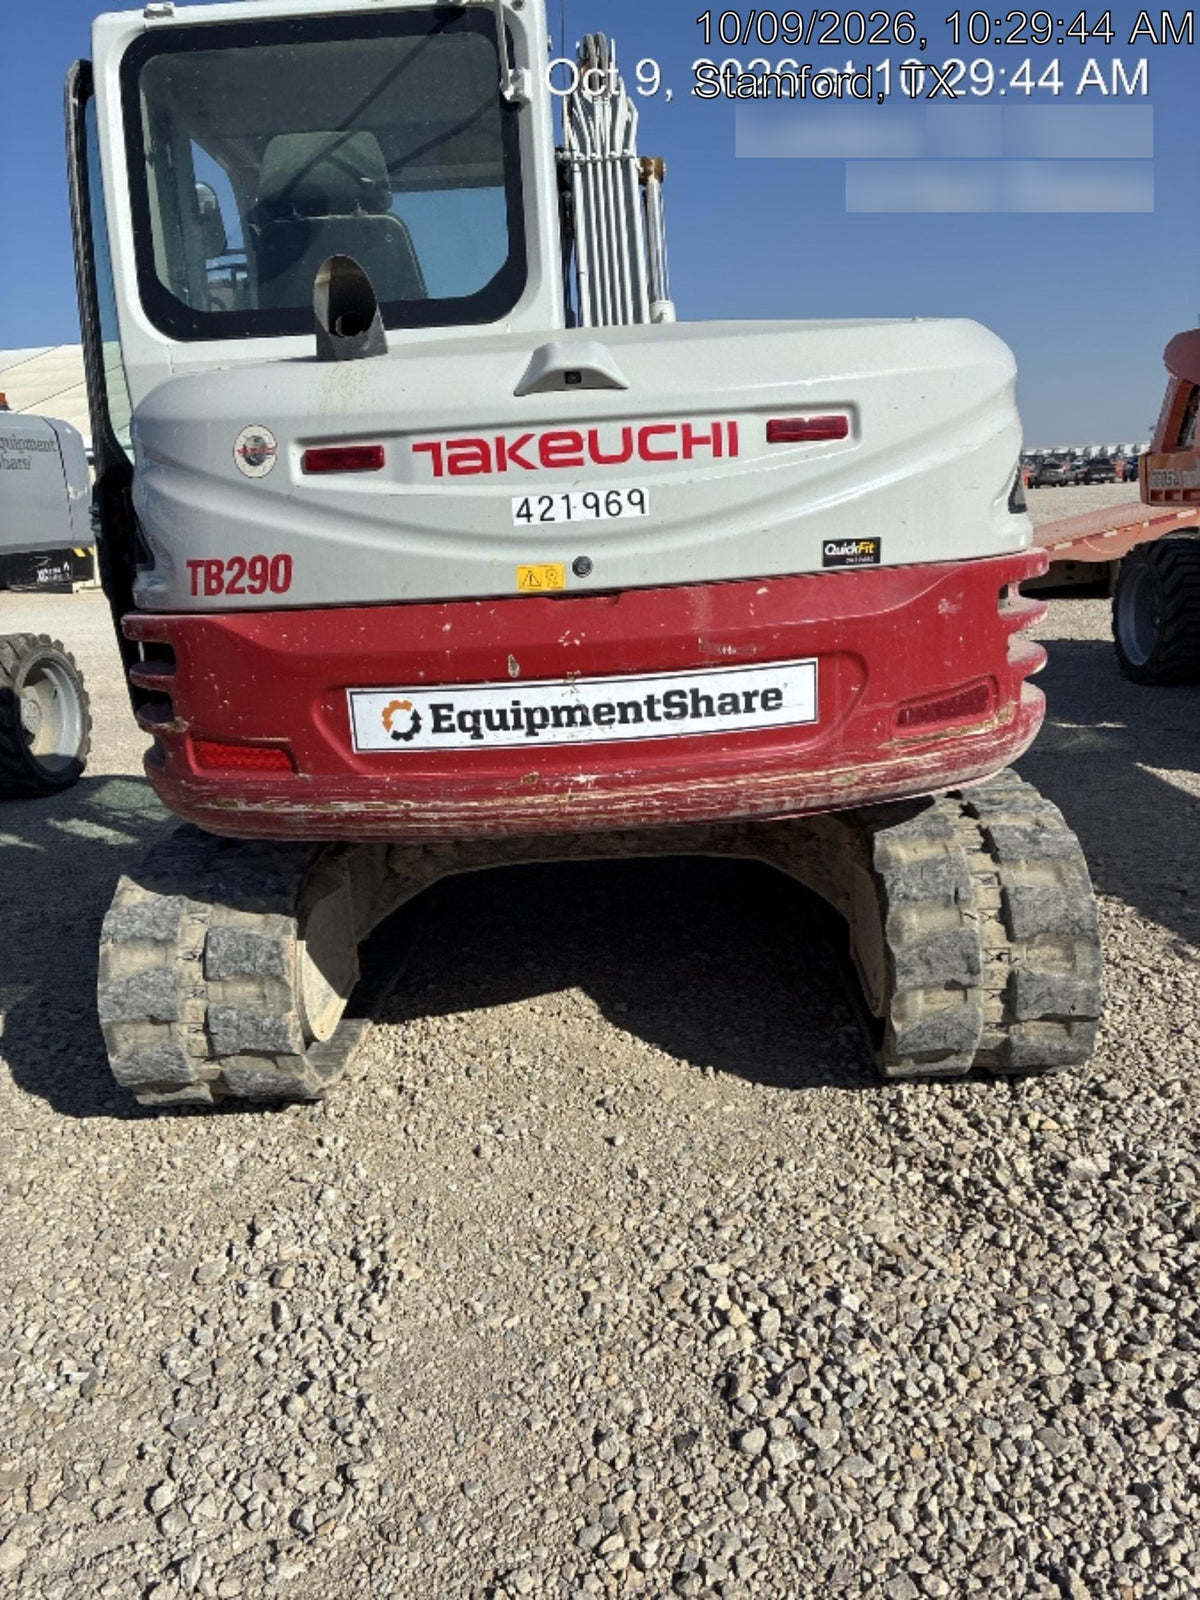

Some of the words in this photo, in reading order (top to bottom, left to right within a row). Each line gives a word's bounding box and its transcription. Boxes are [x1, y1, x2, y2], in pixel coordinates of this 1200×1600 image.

[412, 421, 739, 478] TAKEUCHI
[186, 554, 293, 597] TB290
[429, 687, 784, 740] EquipmentShare
